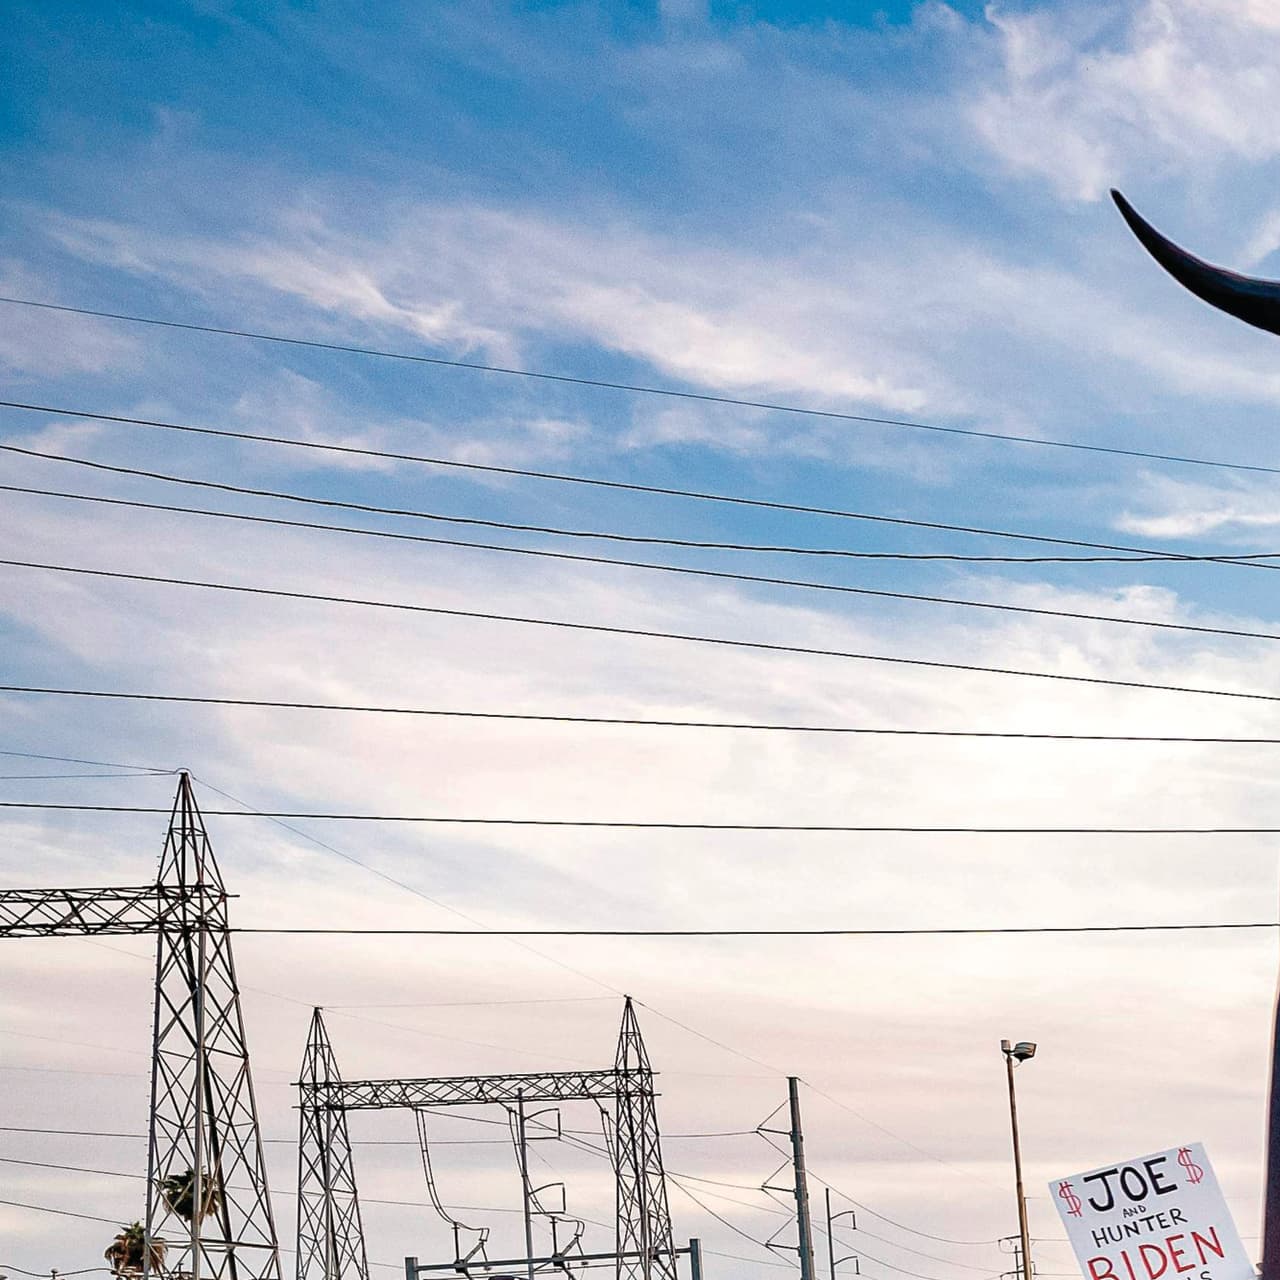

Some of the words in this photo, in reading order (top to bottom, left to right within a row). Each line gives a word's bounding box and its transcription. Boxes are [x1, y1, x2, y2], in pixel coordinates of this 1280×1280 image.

[1083, 1156, 1178, 1212] JOE
[1091, 1208, 1188, 1248] HUNTER
[1122, 1204, 1147, 1218] AND
